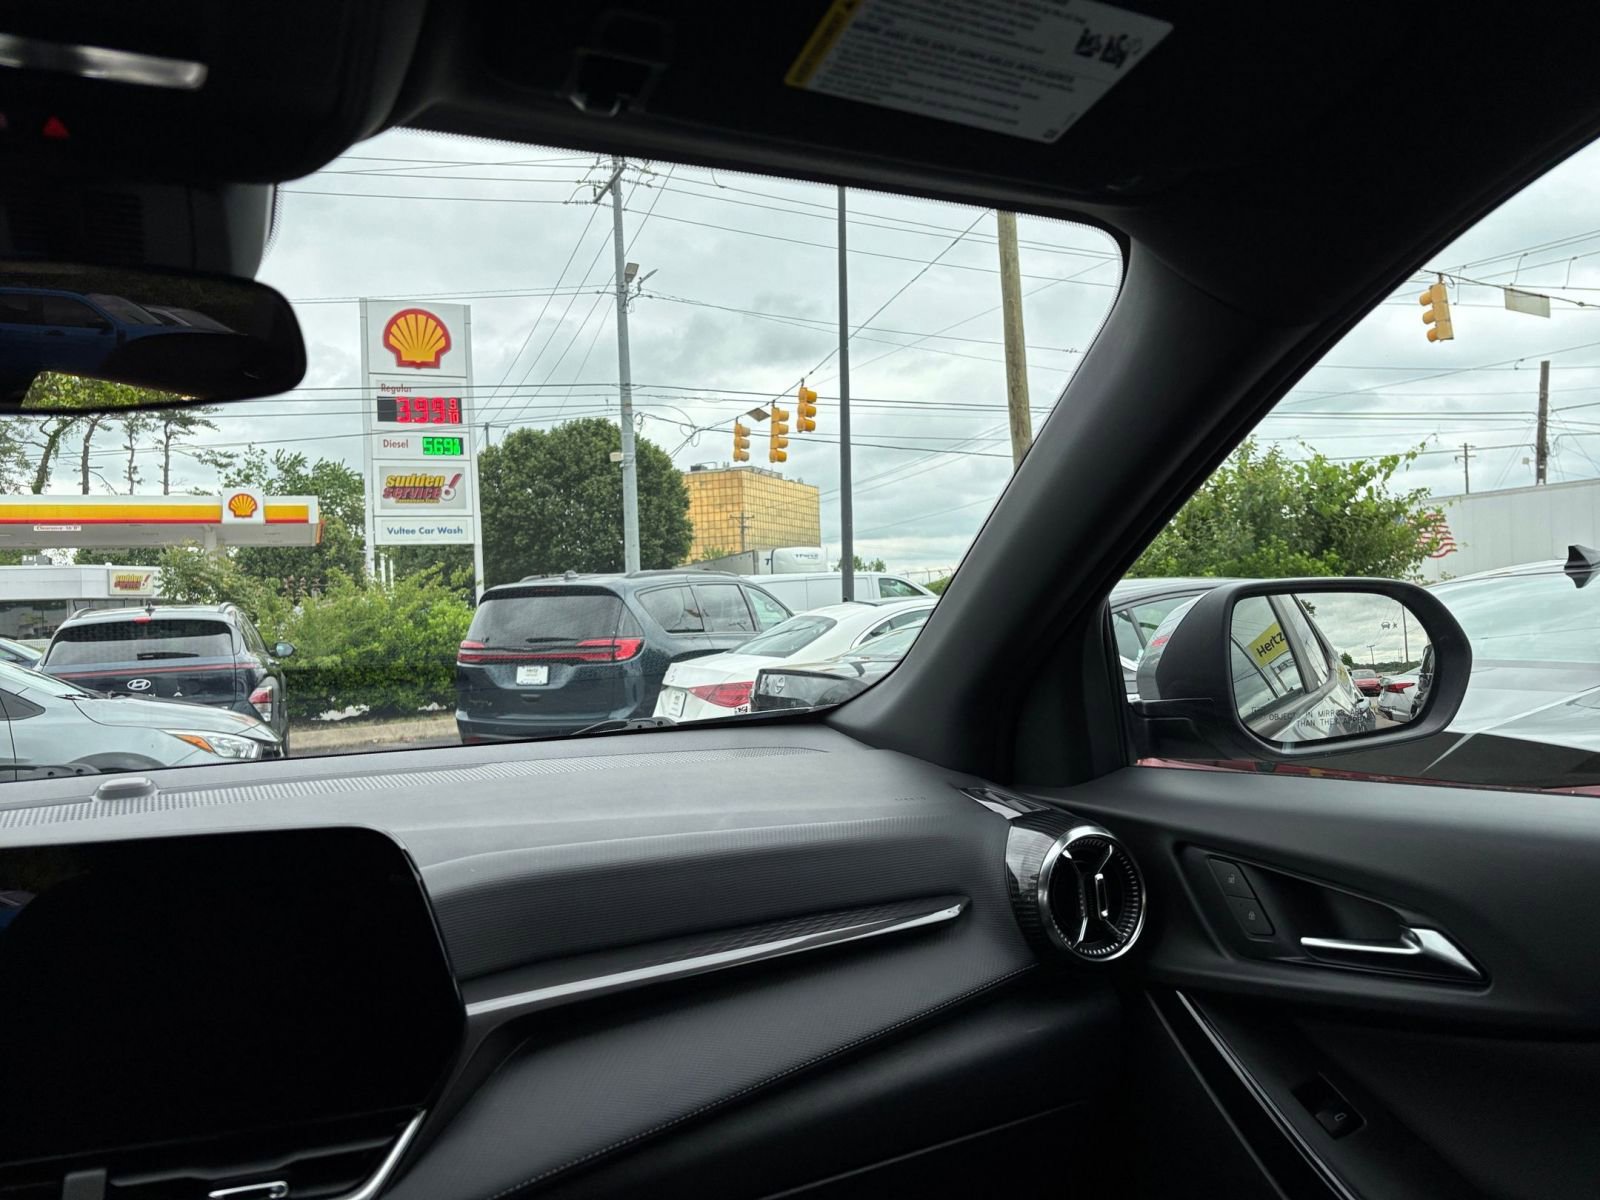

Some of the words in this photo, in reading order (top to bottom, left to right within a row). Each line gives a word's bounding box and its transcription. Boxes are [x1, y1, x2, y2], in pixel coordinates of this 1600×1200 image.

[380, 383, 412, 394] Regular
[382, 439, 409, 449] Diesel
[387, 526, 416, 535] Vultee
[418, 526, 435, 535] Car
[437, 525, 463, 535] Wash
[1256, 631, 1285, 657] Hertz
[1296, 719, 1316, 728] THAN
